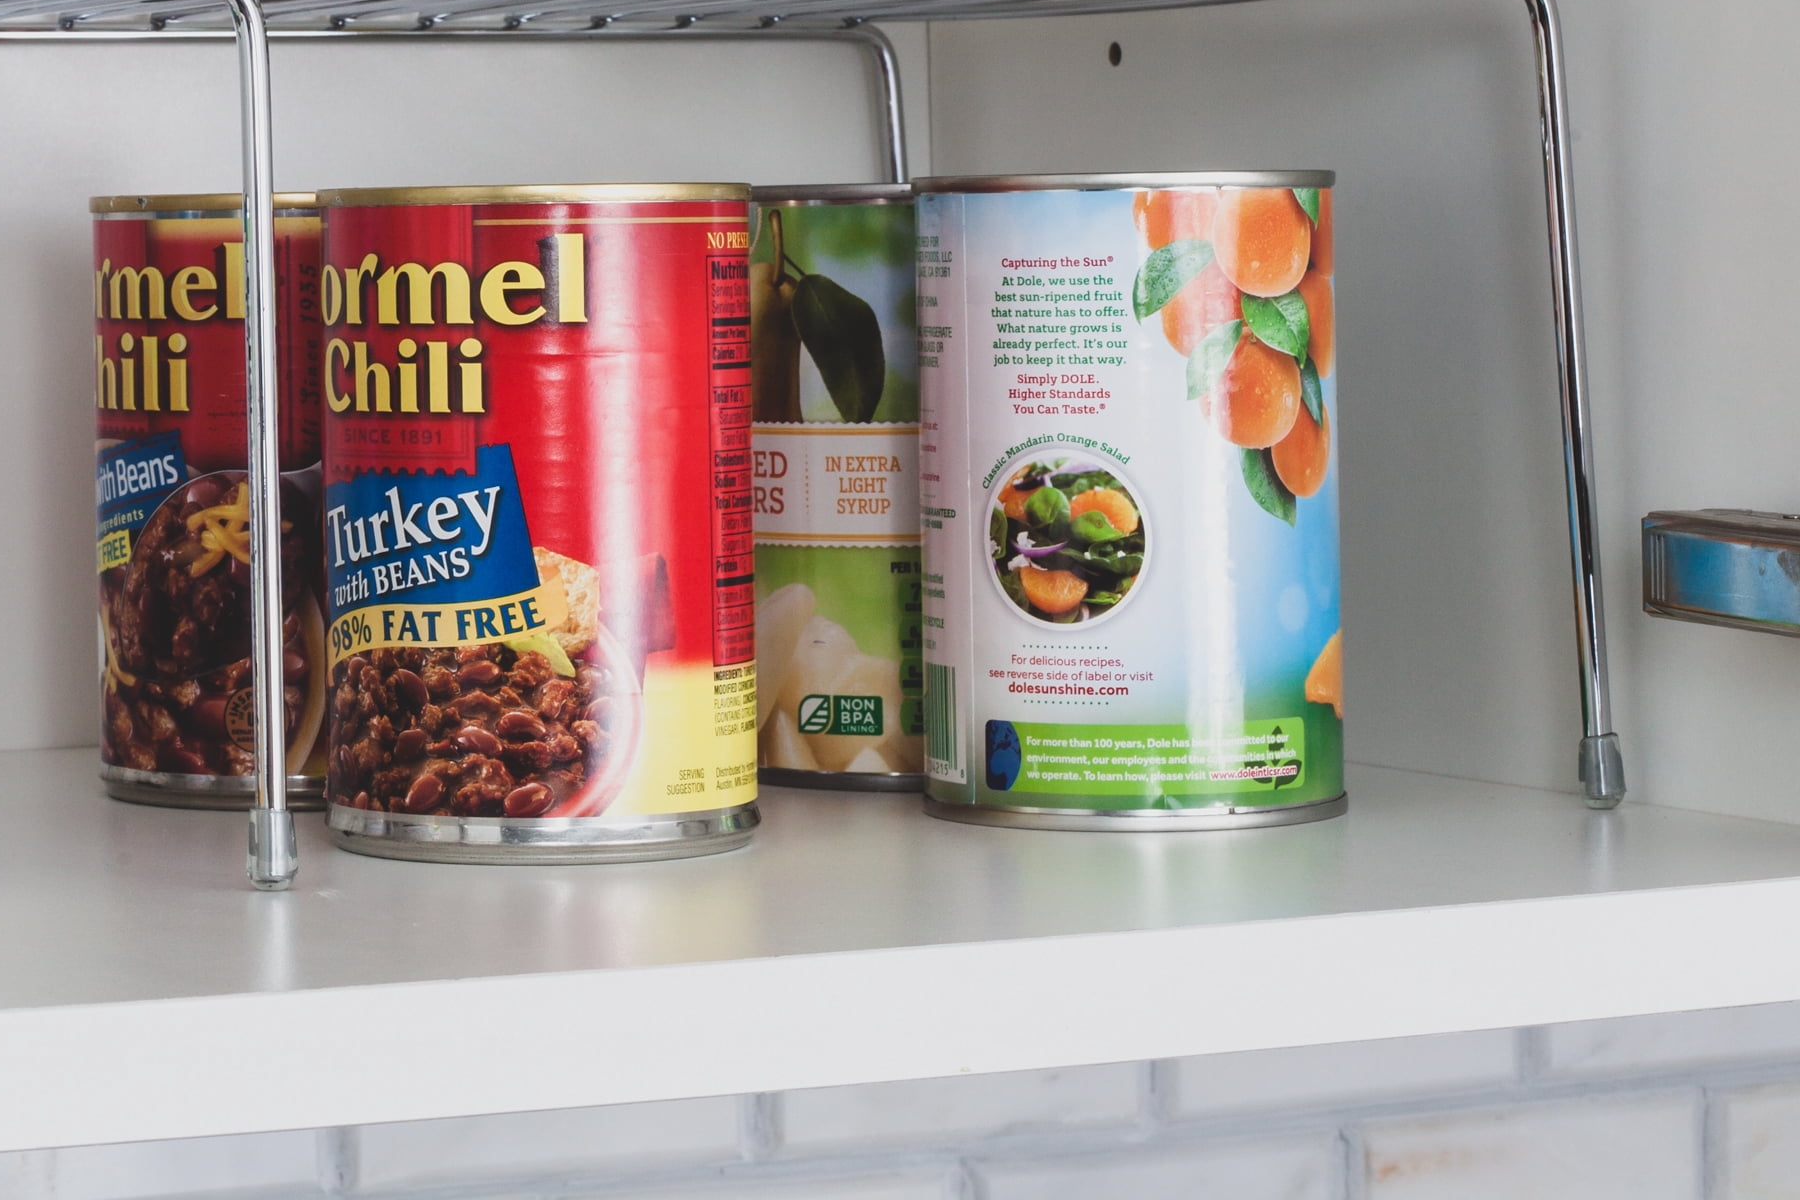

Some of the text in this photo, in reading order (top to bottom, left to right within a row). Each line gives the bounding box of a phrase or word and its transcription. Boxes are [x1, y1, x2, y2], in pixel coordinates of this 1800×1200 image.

[1001, 257, 1056, 270] Capturing
[1020, 291, 1090, 304] sun-ripened
[1029, 324, 1108, 336] nature grows
[992, 339, 1080, 351] already perfect.
[325, 338, 485, 414] Chili
[1017, 373, 1099, 386] Simply DOLE.
[1008, 388, 1110, 400] Higher Standards
[344, 429, 443, 445] SINCE 1891
[1005, 433, 1131, 466] Mandarin Orange Salad
[846, 456, 902, 473] EXTRA
[115, 454, 178, 497] Beans
[839, 478, 888, 494] LIGHT
[837, 498, 892, 515] SYRUP
[327, 486, 500, 568] Turkey
[103, 536, 127, 564] FREE
[335, 548, 471, 607] with BEANS
[332, 598, 546, 654] 98% FAT FREE
[1029, 656, 1125, 670] delicious recipes,
[1008, 682, 1129, 696] dolesunshine.com
